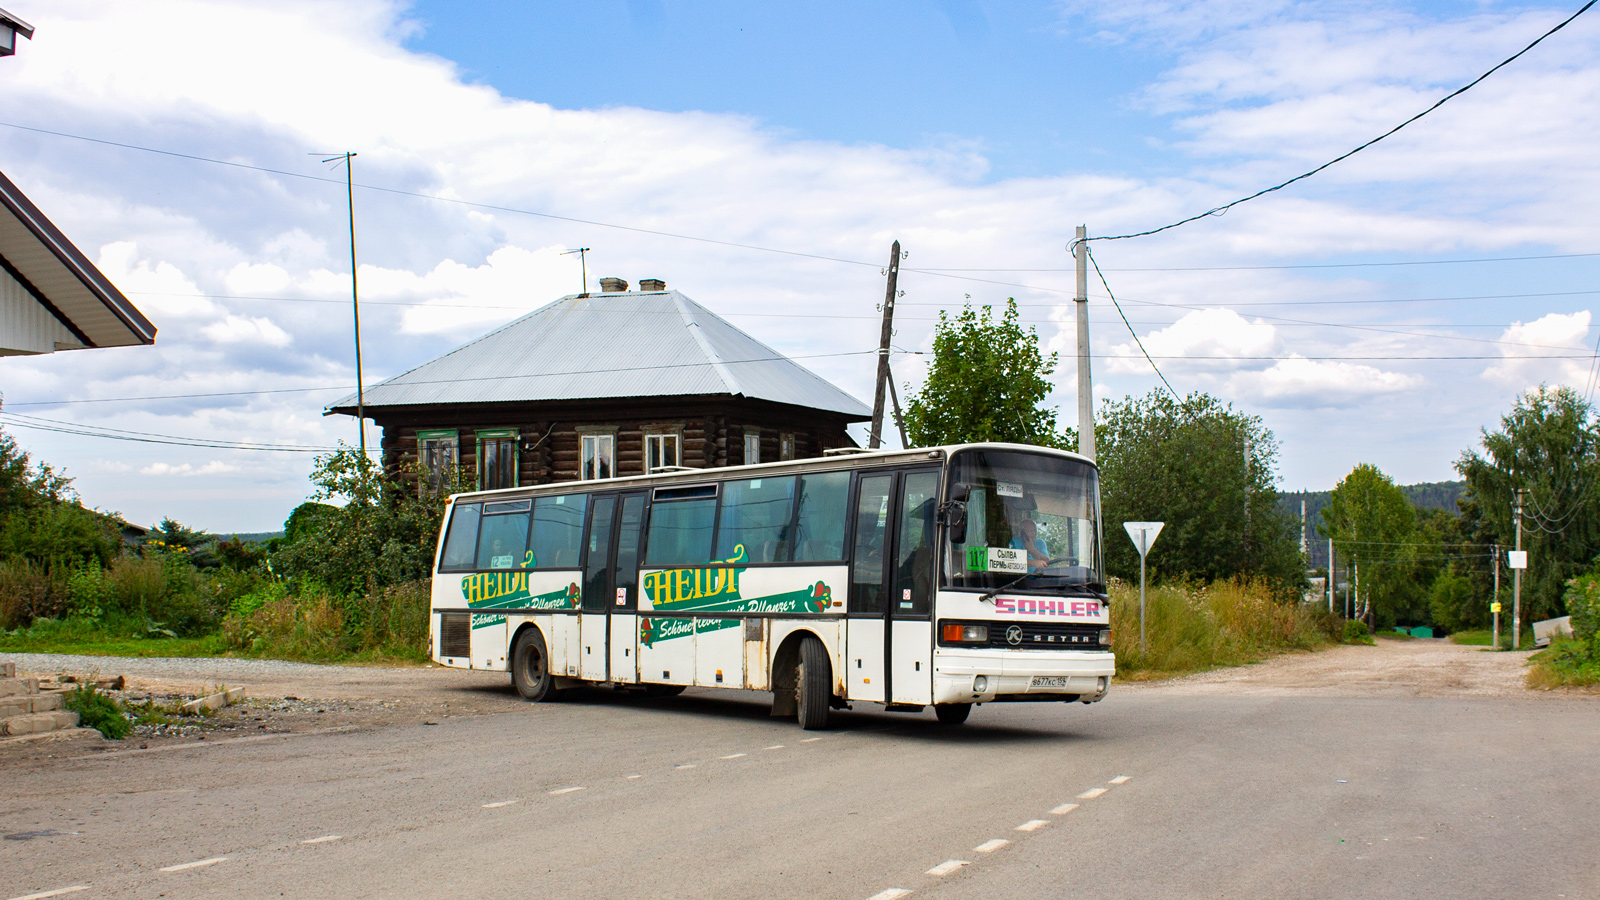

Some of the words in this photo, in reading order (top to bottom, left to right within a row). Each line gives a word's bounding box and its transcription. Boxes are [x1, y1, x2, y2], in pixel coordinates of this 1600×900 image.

[969, 549, 985, 567] 117
[462, 550, 533, 603] HEIDI
[645, 543, 744, 606] HEIDI
[995, 598, 1101, 617] SOHLER
[1033, 635, 1090, 643] SETRA
